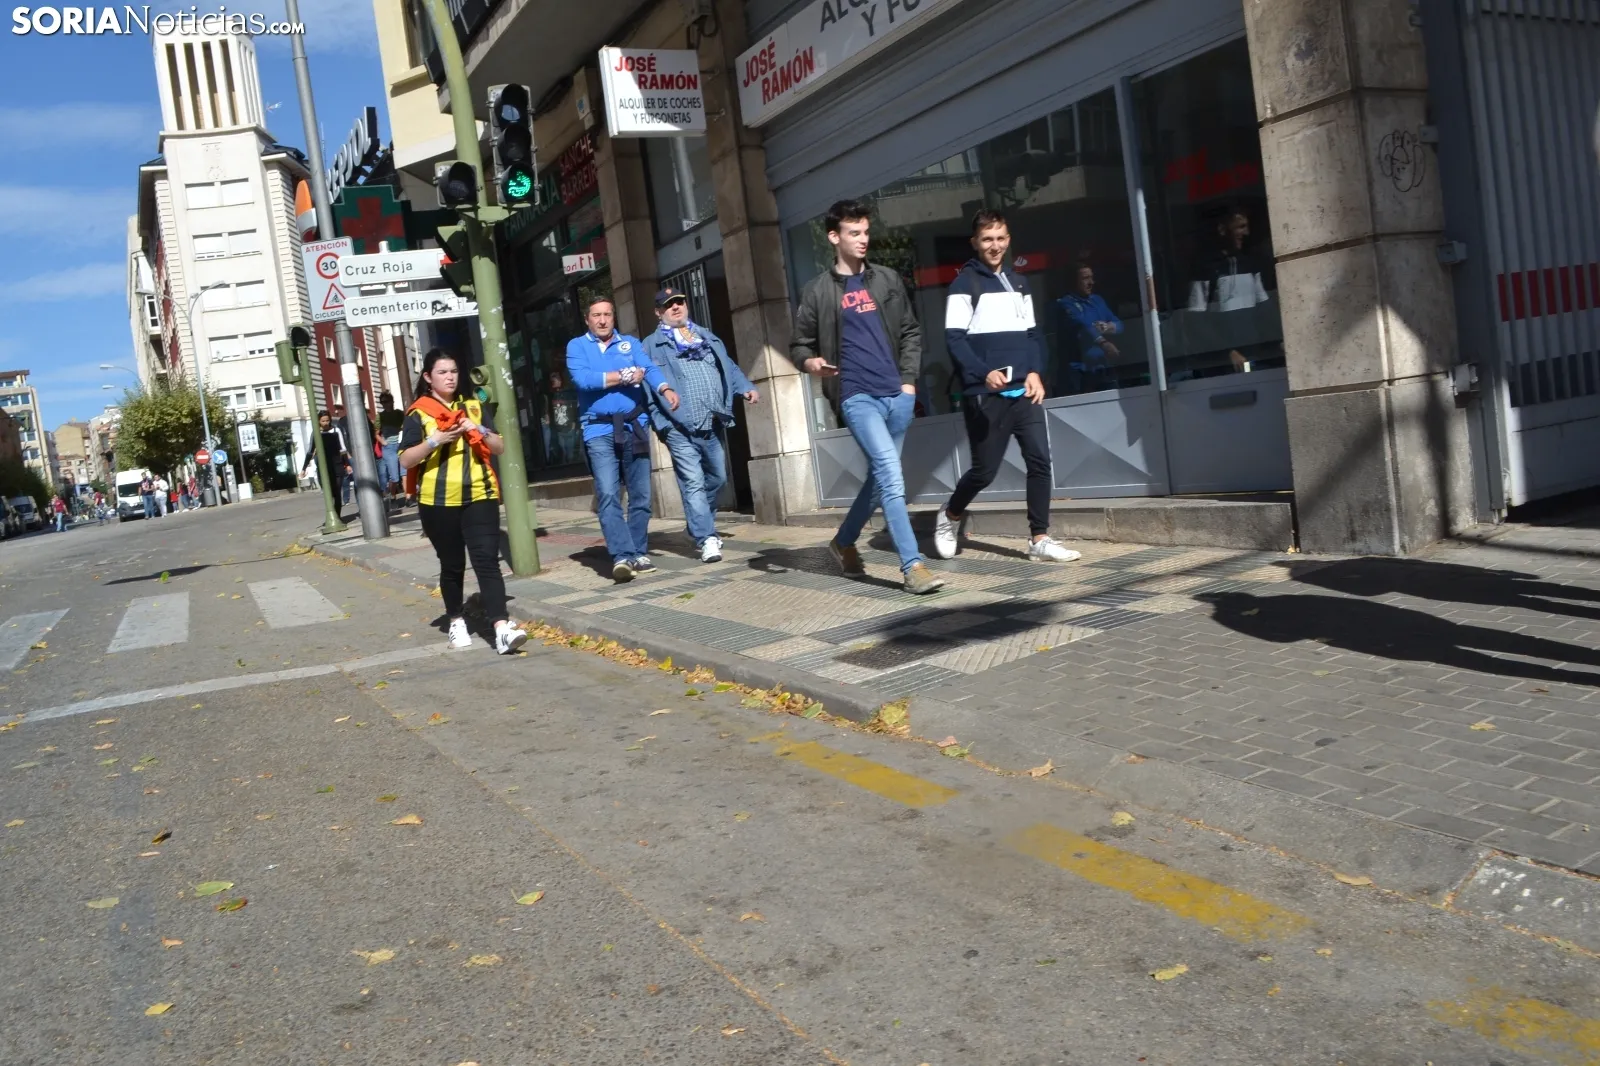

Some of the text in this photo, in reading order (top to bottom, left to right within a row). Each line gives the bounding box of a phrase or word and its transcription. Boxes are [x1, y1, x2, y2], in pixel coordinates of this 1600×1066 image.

[861, 3, 877, 37] Y
[614, 53, 656, 72] JOSÉ
[743, 37, 777, 88] JOSÉ
[638, 71, 698, 90] RAMÓN
[761, 46, 814, 105] RAMÓN
[619, 97, 702, 109] ALQUILER DE COCHES
[633, 112, 692, 124] Y FURGONETAS
[560, 133, 594, 176] SANCHE
[321, 260, 337, 271] 30
[345, 262, 413, 276] Cruz Roja
[315, 310, 345, 319] CICLOCA
[351, 300, 428, 316] cementerio
